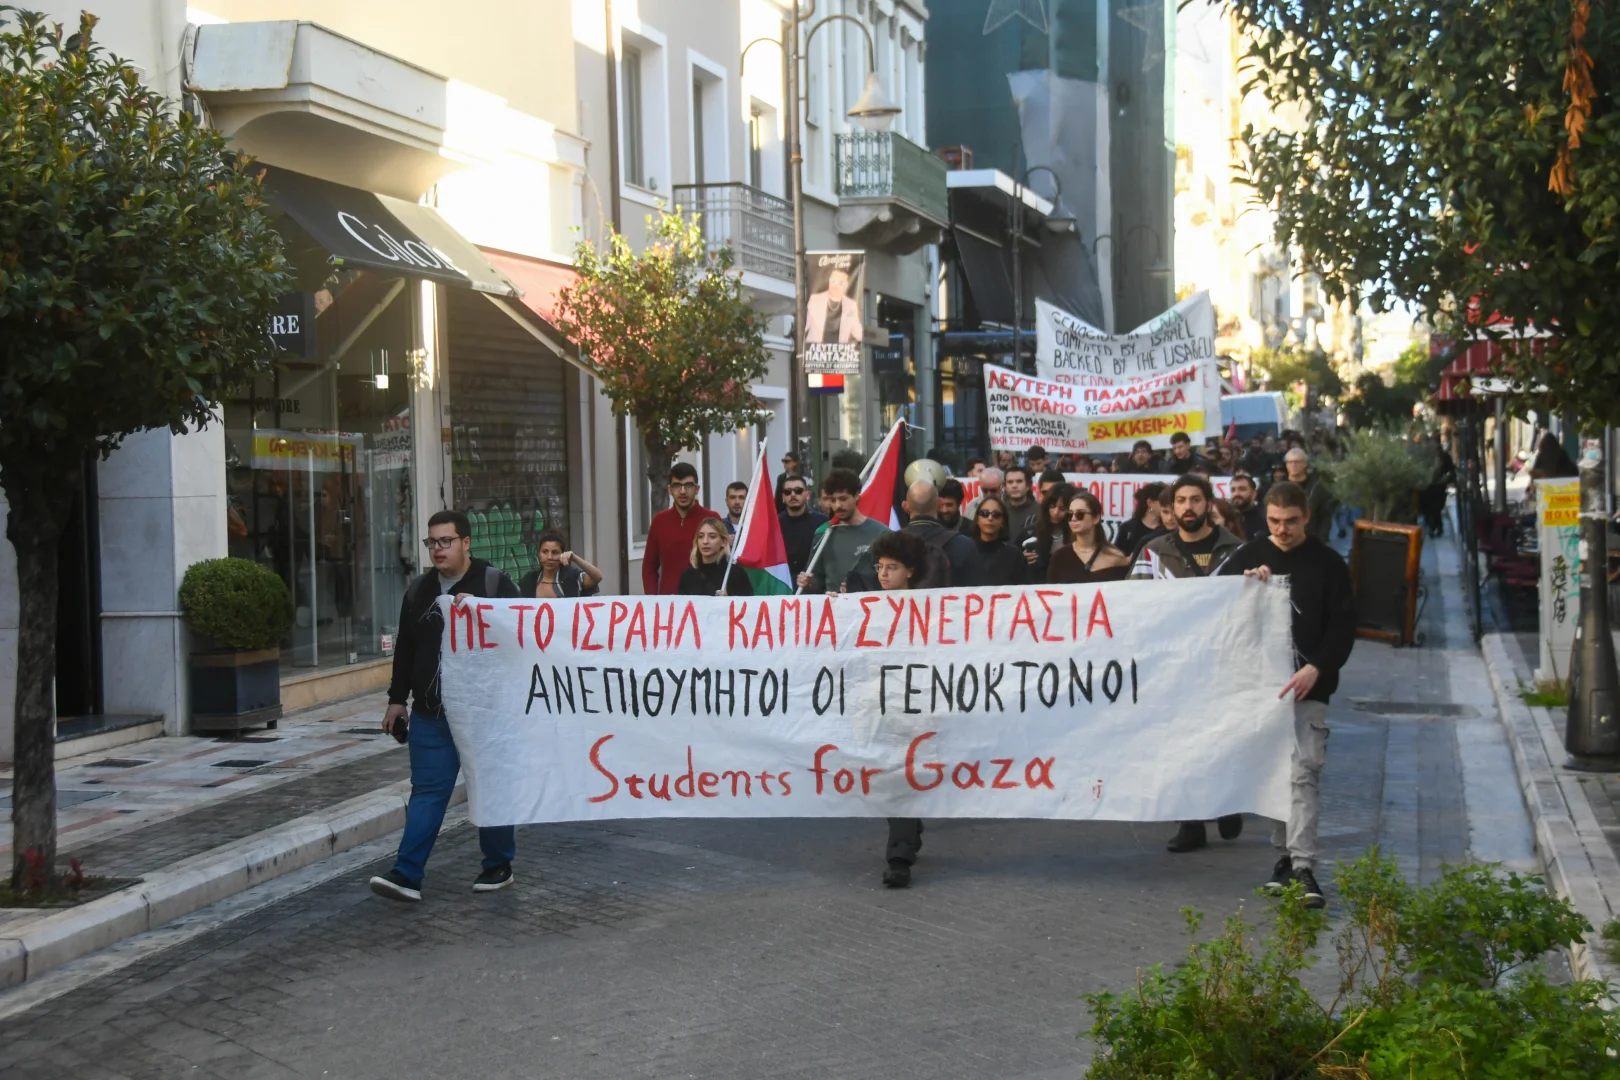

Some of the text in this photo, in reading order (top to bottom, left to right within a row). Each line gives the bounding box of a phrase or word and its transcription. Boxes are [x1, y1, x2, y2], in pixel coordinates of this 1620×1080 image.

[805, 351, 860, 361] ΠΑΝΤΑΖΗΣ
[809, 343, 856, 352] ΛΕΥΤΕΡΗΣ
[1053, 349, 1103, 375] BACKED
[1113, 358, 1126, 375] BY
[1137, 352, 1159, 371] THE
[988, 369, 1073, 399] ΛΕΥΤΕΡΗ
[989, 394, 1010, 402] ΑΠΟ
[1010, 395, 1077, 416] ΠΟΤΑΜΟ
[1099, 388, 1186, 414] ΘΑΛΑΣΣΑ
[990, 403, 1009, 412] ΤΟΝ
[989, 416, 1066, 430] ΝΑ ΣΤΑΜΑΤΗΣΕΙ
[1009, 436, 1033, 446] ΣΤΗΝ
[450, 588, 1113, 653] ΜΕ ΤΟ ΙΣΡΑΗΛ ΚΑΜΙΑ ΣΥΝΕΡΓΑΣΙΑ
[525, 657, 1139, 718] ΑΝΕΠΙΘΥΜΗΤΟΙ ΟΙ ΓΕΝΟΚΤΟΝΟΙ
[587, 731, 1056, 803] Students for Gaza
